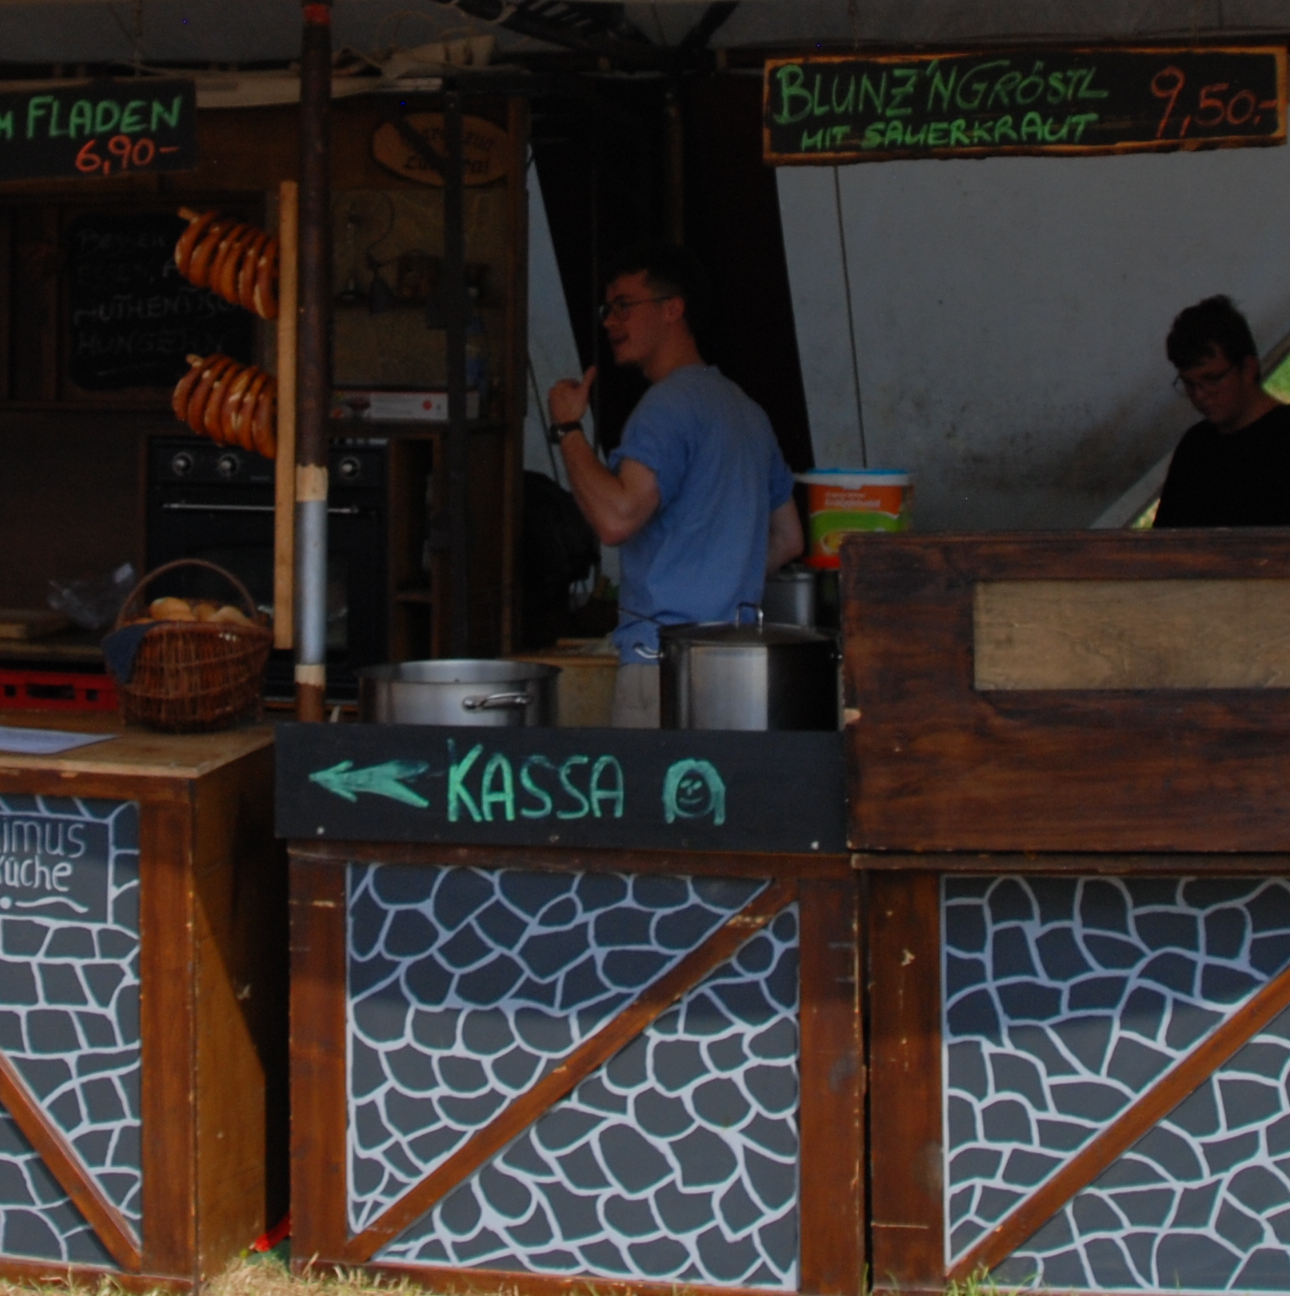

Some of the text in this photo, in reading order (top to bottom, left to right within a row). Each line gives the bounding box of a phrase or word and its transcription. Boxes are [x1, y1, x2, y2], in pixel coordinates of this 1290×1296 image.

[26, 95, 183, 139] FLADEN
[800, 111, 1100, 151] MIT SAUERKRAUT
[447, 738, 625, 822] KASSA
